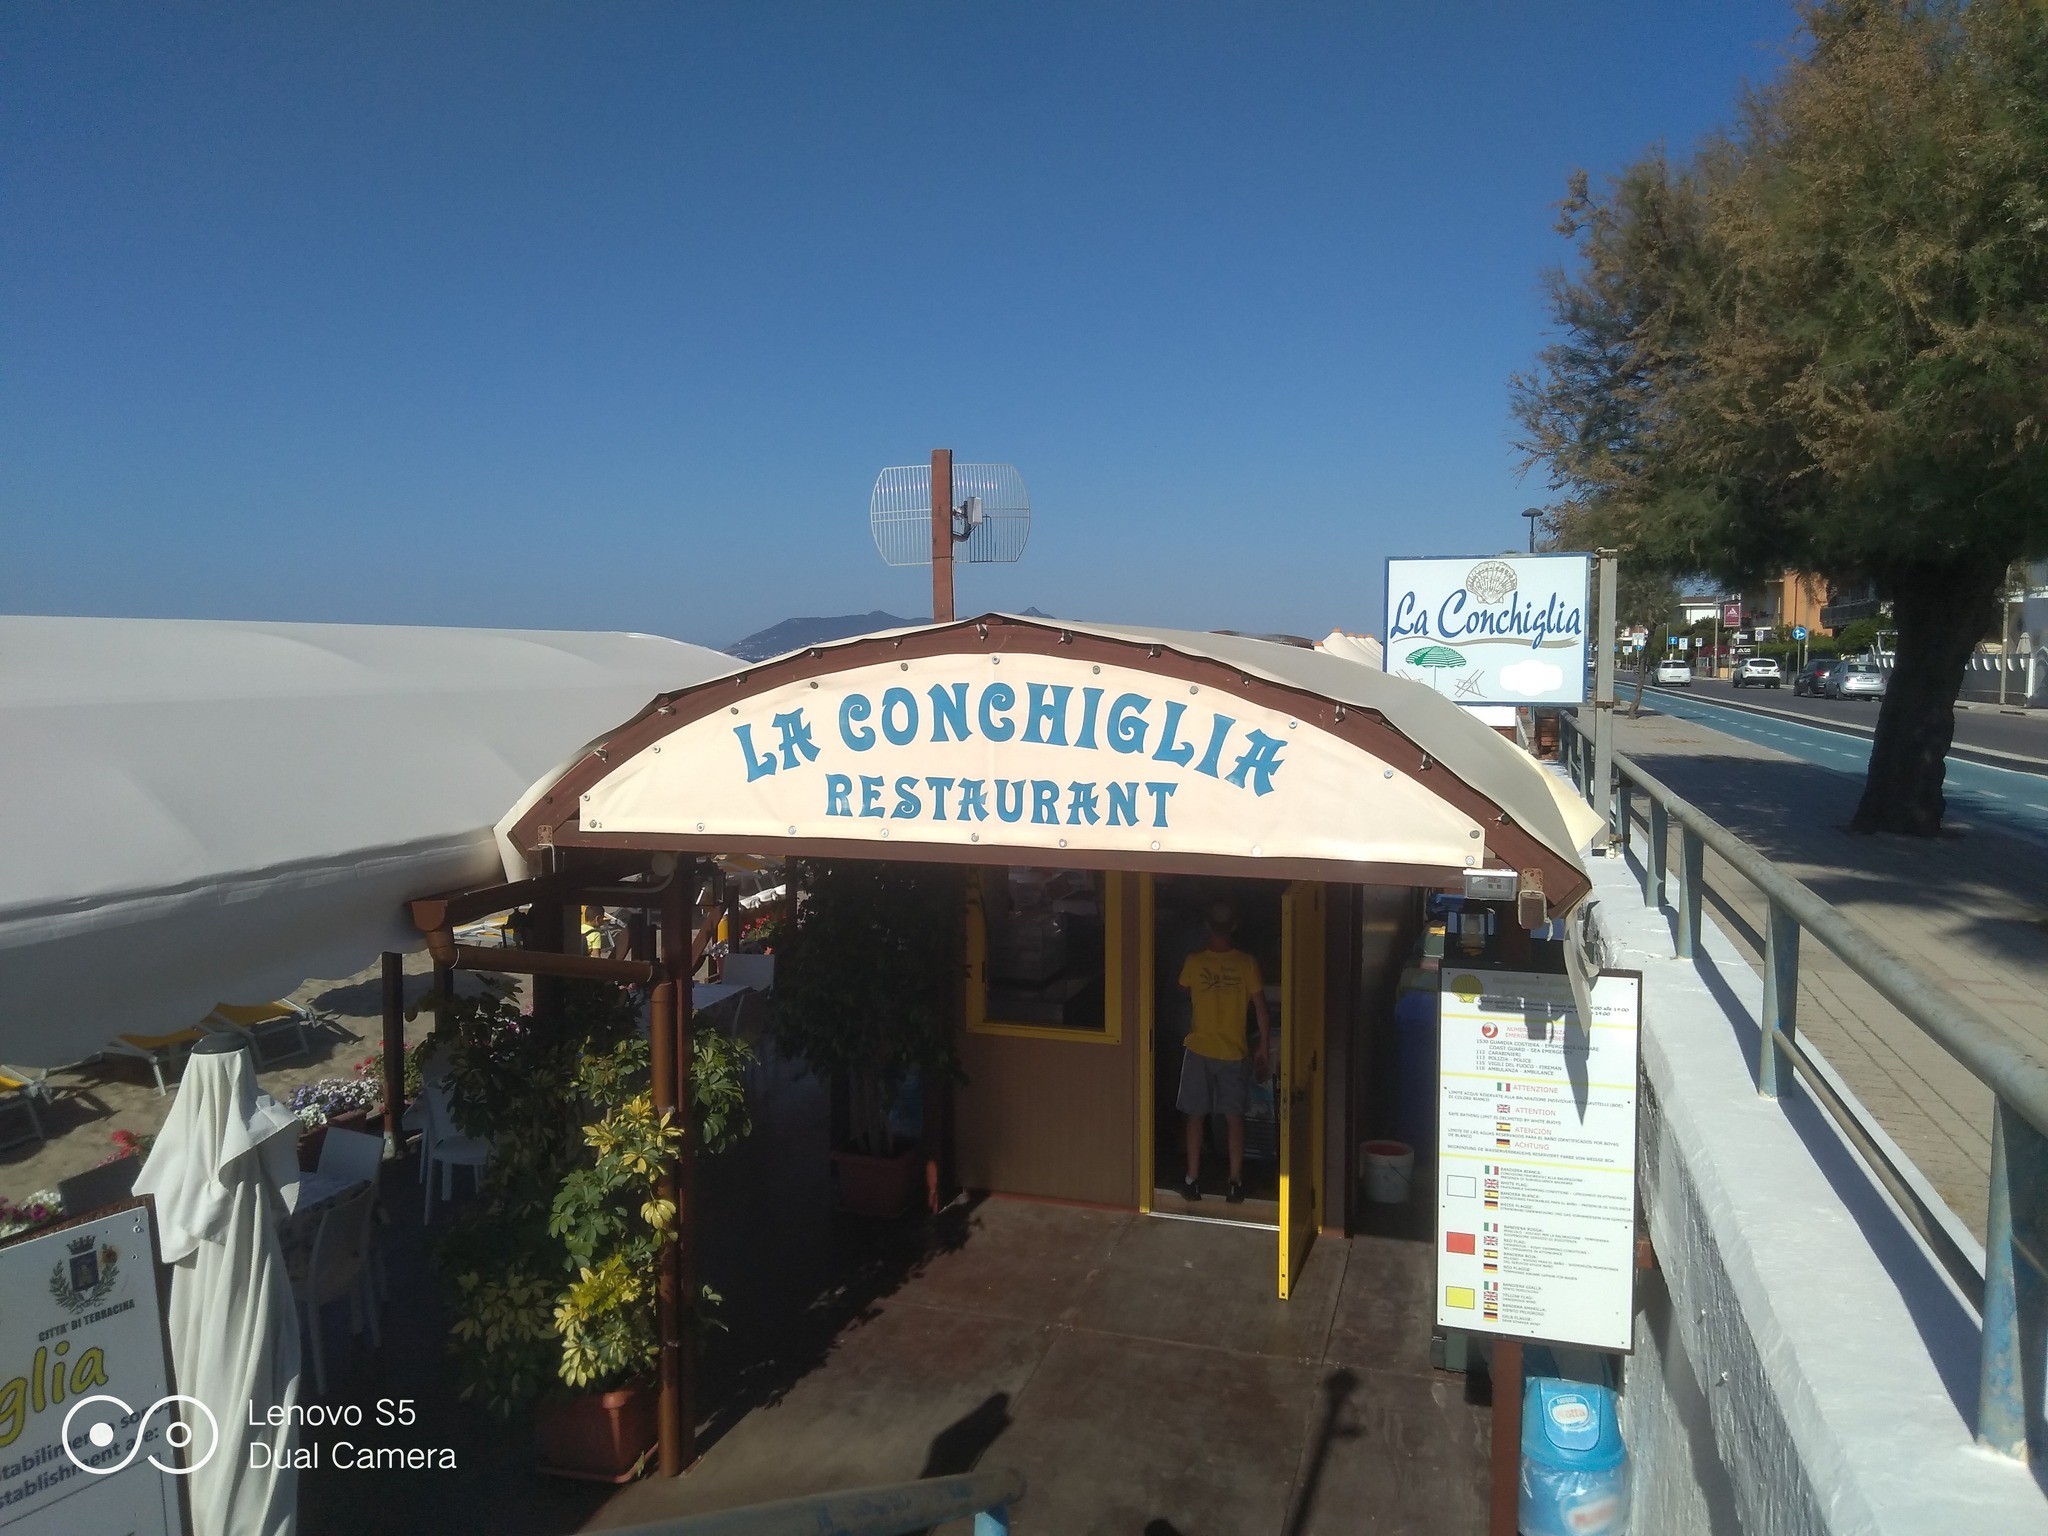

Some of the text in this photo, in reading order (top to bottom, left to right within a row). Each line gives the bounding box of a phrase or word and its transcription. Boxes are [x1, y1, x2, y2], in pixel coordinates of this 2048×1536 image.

[1390, 589, 1582, 650] La Conchiglia
[732, 680, 1288, 796] LA CONCHIGLIA
[824, 772, 1177, 829] RESTAURANT
[1513, 1085, 1558, 1094] ATTENZIONE
[1515, 1107, 1556, 1116] ATTENTION
[1515, 1141, 1549, 1150] ACHTUNG
[71, 1319, 82, 1331] DI
[83, 1299, 135, 1325] TERRACINA
